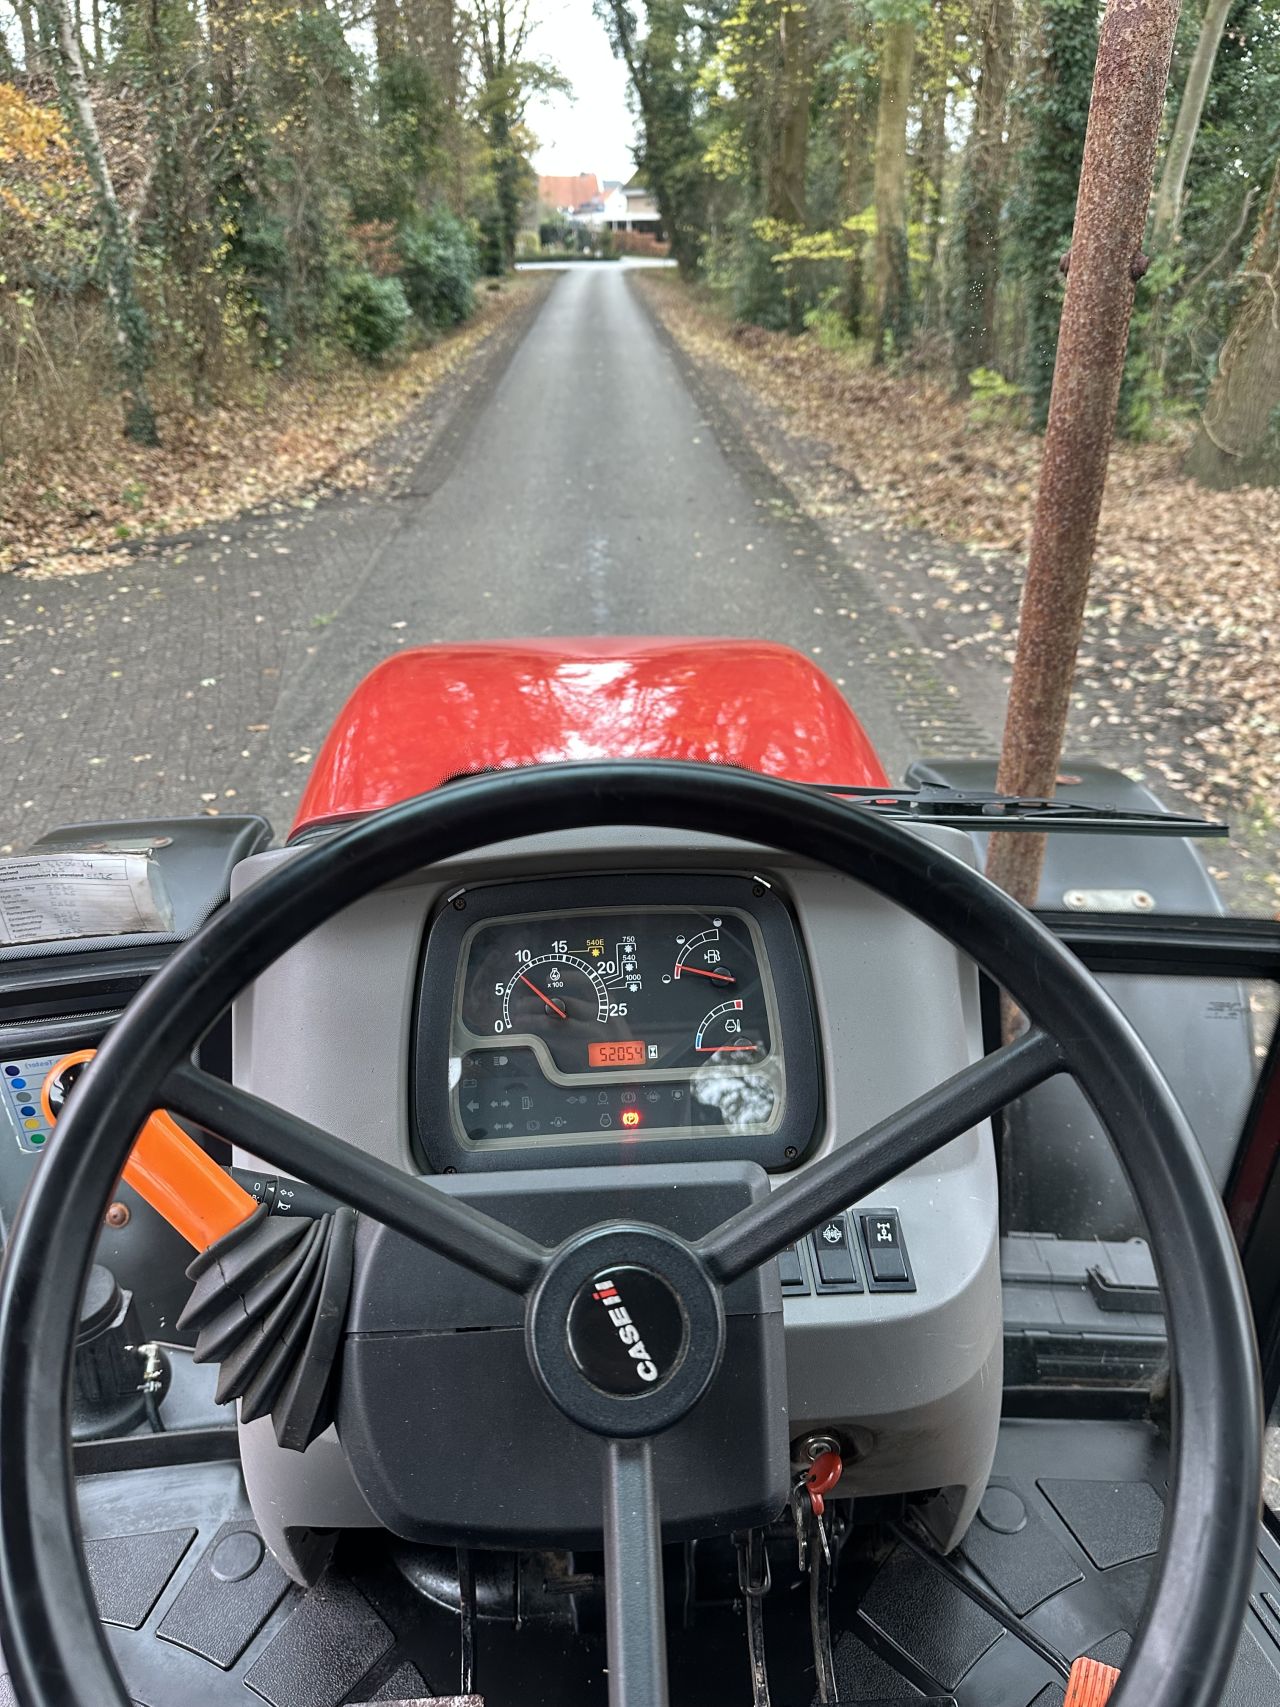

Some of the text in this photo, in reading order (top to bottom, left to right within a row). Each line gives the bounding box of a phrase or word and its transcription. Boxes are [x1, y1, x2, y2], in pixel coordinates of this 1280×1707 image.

[551, 940, 568, 953] 15
[514, 950, 531, 963] 10
[597, 961, 615, 974] 20
[495, 983, 504, 996] 5
[609, 1003, 628, 1016] 25
[494, 1020, 503, 1033] 0
[608, 1306, 658, 1382] CASE
